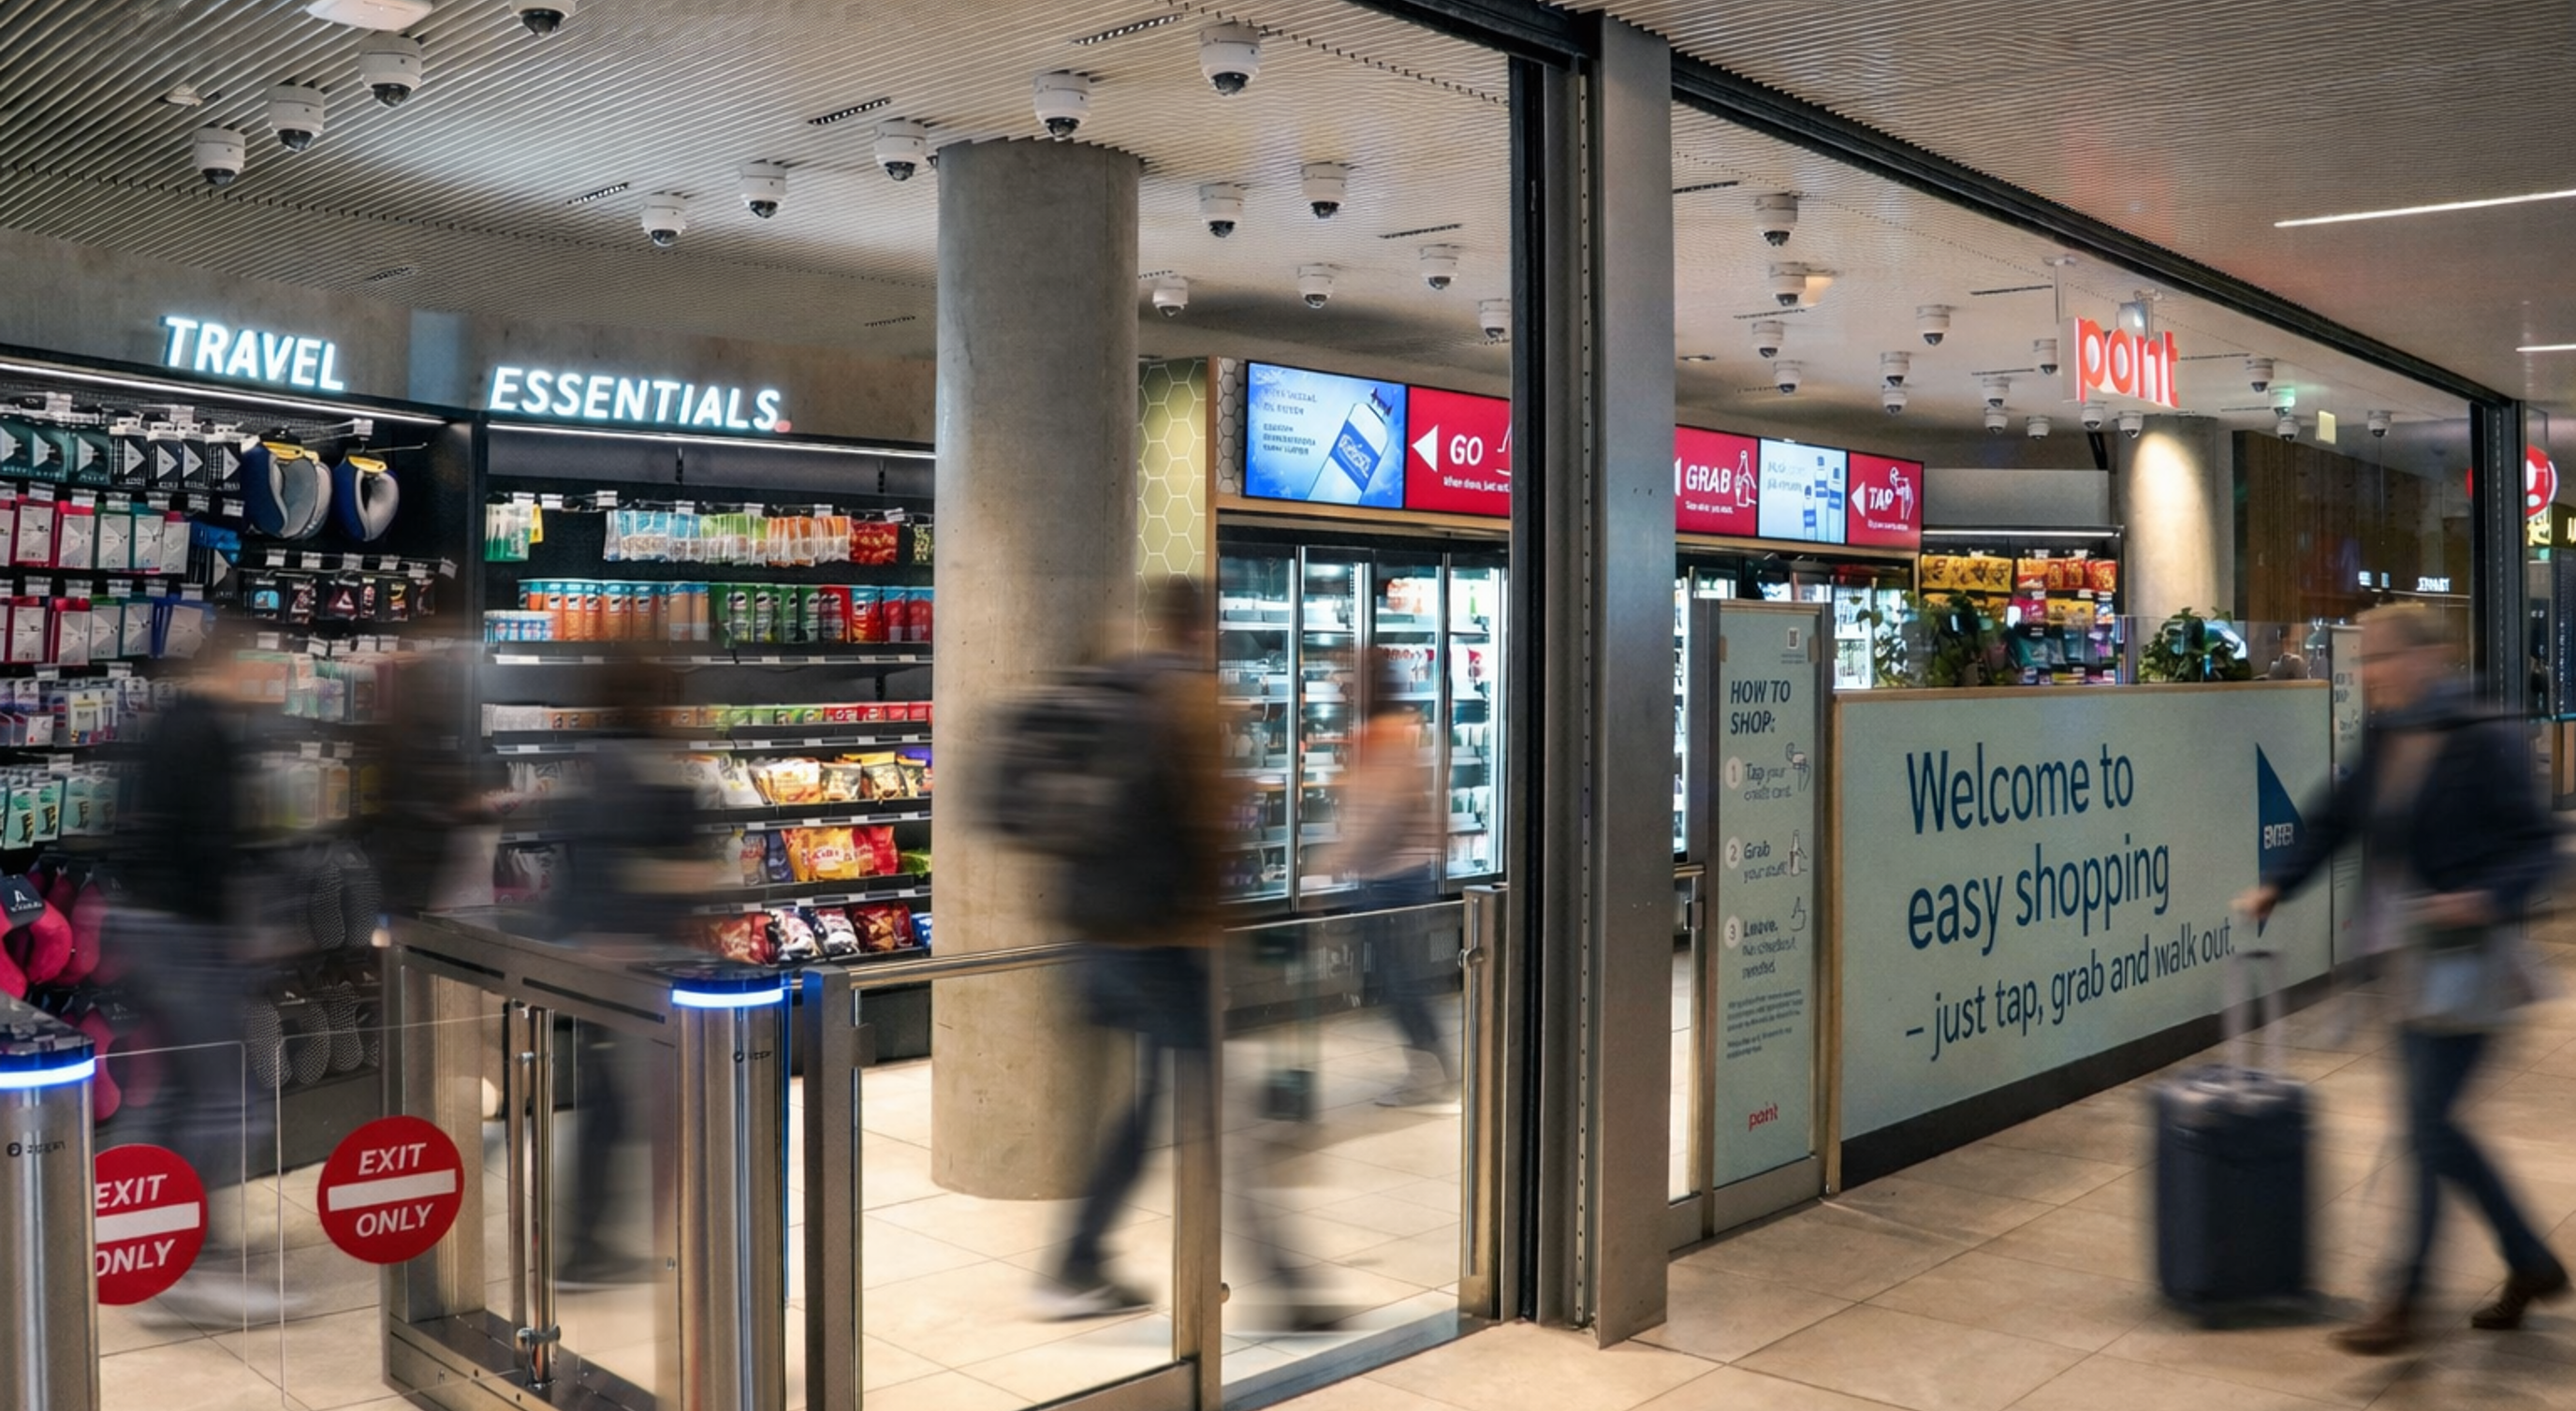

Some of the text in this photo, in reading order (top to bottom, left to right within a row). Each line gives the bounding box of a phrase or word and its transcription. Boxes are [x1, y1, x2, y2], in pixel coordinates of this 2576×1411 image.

[160, 316, 344, 391] TRAVEL
[1450, 434, 1483, 466] GO
[1686, 464, 1731, 493] GRAB
[1868, 487, 1895, 511] TAP
[1731, 680, 1791, 705] HOW TO
[1906, 742, 2135, 834] Welcome to
[1907, 833, 2170, 956] easy shopping
[1995, 977, 2044, 1036] tap,
[2051, 948, 2104, 1025] grab
[2110, 933, 2150, 992] and
[2154, 922, 2198, 978] walk
[2202, 917, 2236, 963] out.
[359, 1143, 426, 1176] EXIT
[95, 1174, 168, 1209] EXIT
[355, 1203, 434, 1238] ONLY
[95, 1239, 176, 1277] ONLY
